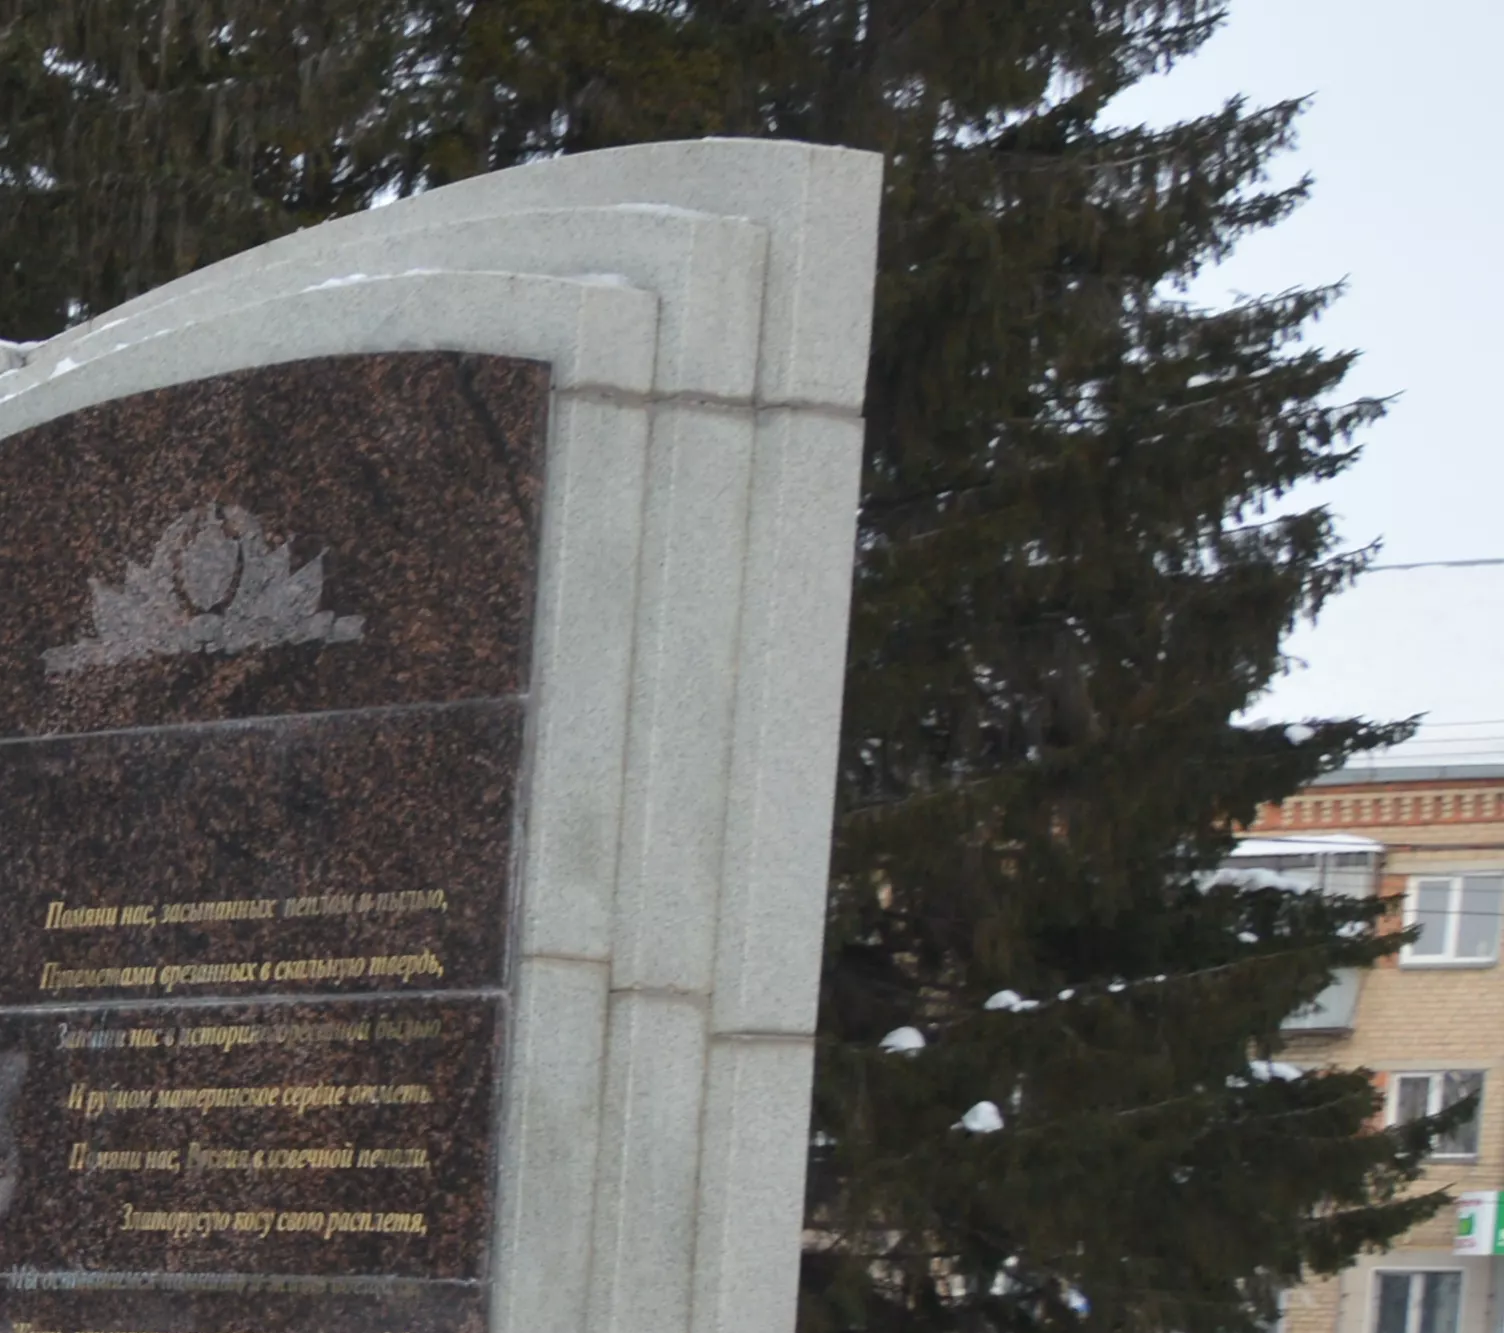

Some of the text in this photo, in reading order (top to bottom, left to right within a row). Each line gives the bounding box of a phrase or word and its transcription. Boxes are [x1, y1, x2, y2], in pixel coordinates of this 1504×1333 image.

[44, 901, 118, 929] Помяни
[120, 904, 157, 929] нас,
[160, 899, 277, 924] засыпанных
[159, 962, 258, 992] врезанных
[259, 961, 272, 981] в
[274, 956, 366, 985] скальную
[368, 949, 444, 984] твердь,
[153, 1085, 280, 1116] материнское
[282, 1080, 346, 1115] сердце
[144, 1150, 181, 1175] нас,
[267, 1140, 354, 1169] извечной
[232, 1211, 276, 1239] косу
[276, 1211, 325, 1232] свою
[324, 1211, 428, 1240] расплетя,
